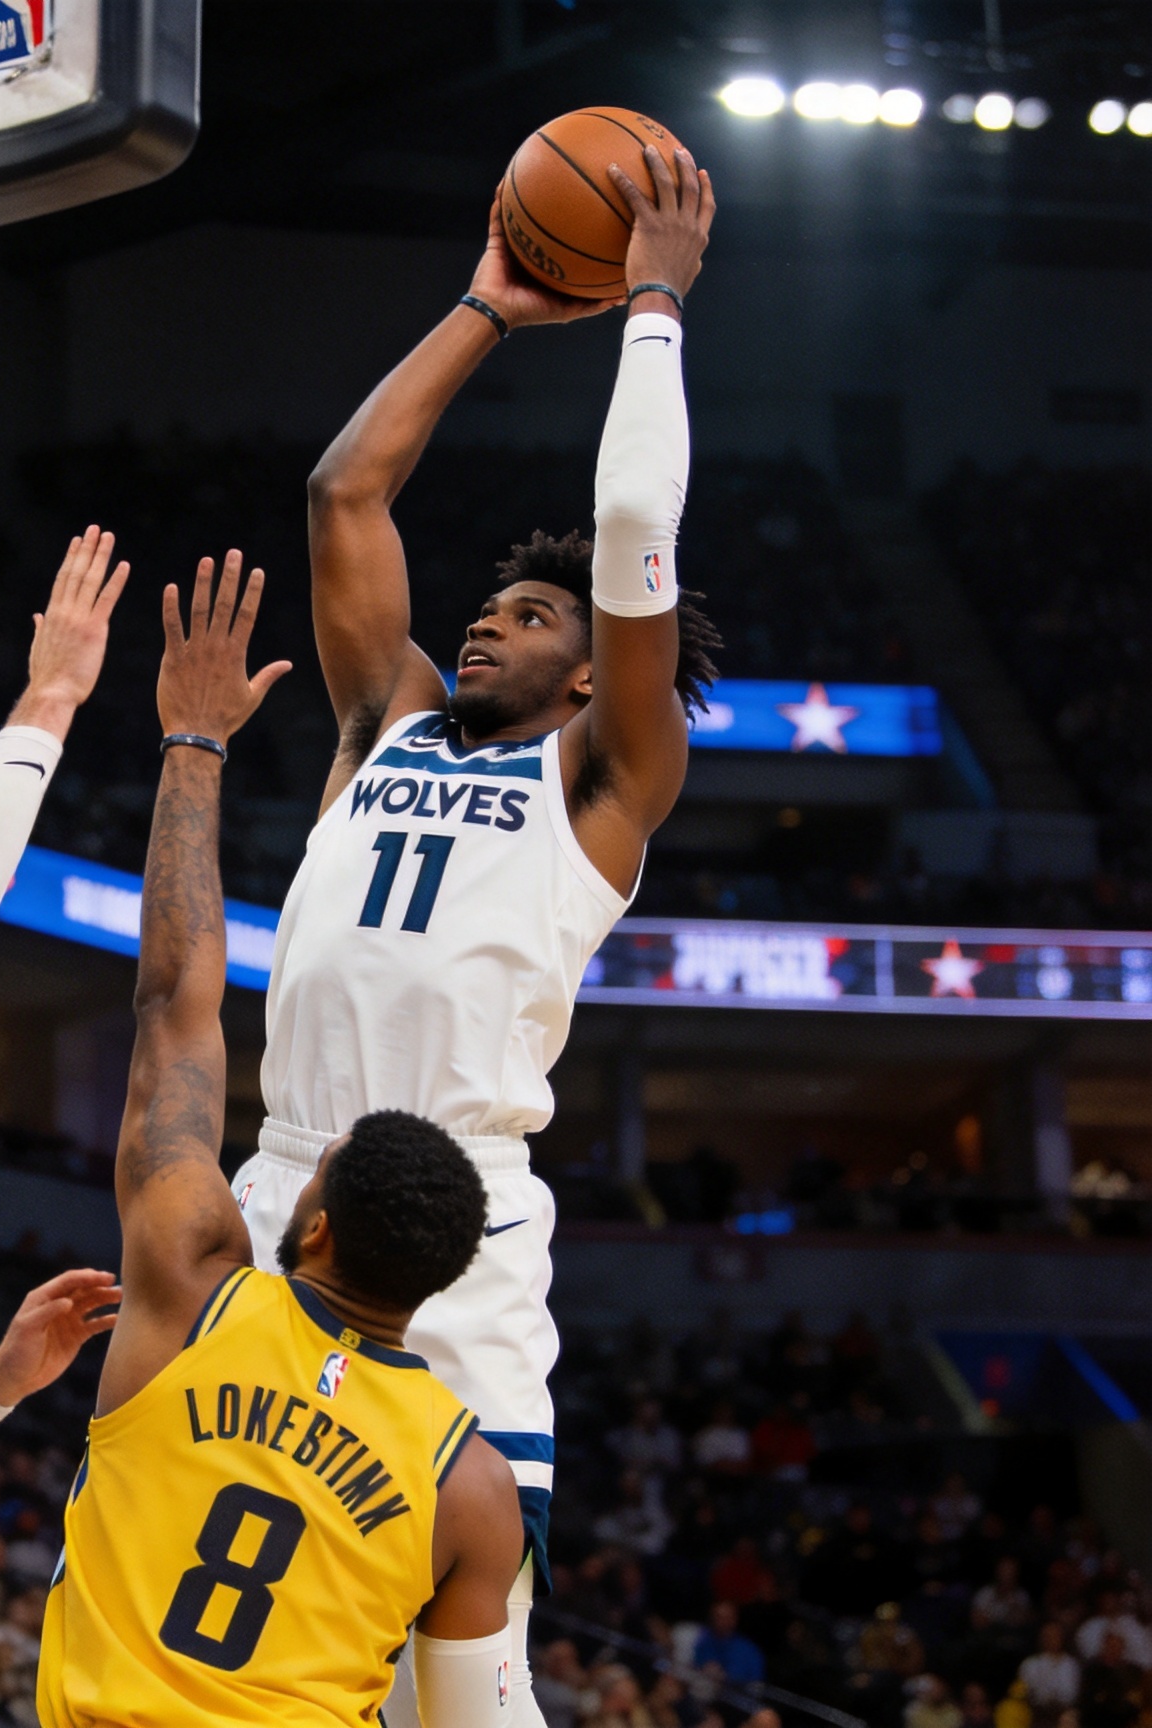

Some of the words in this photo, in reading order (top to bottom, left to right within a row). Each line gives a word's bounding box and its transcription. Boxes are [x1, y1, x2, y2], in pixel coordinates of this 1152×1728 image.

[349, 777, 531, 833] WOLVES
[356, 831, 457, 934] 11
[159, 1482, 307, 1672] 8
